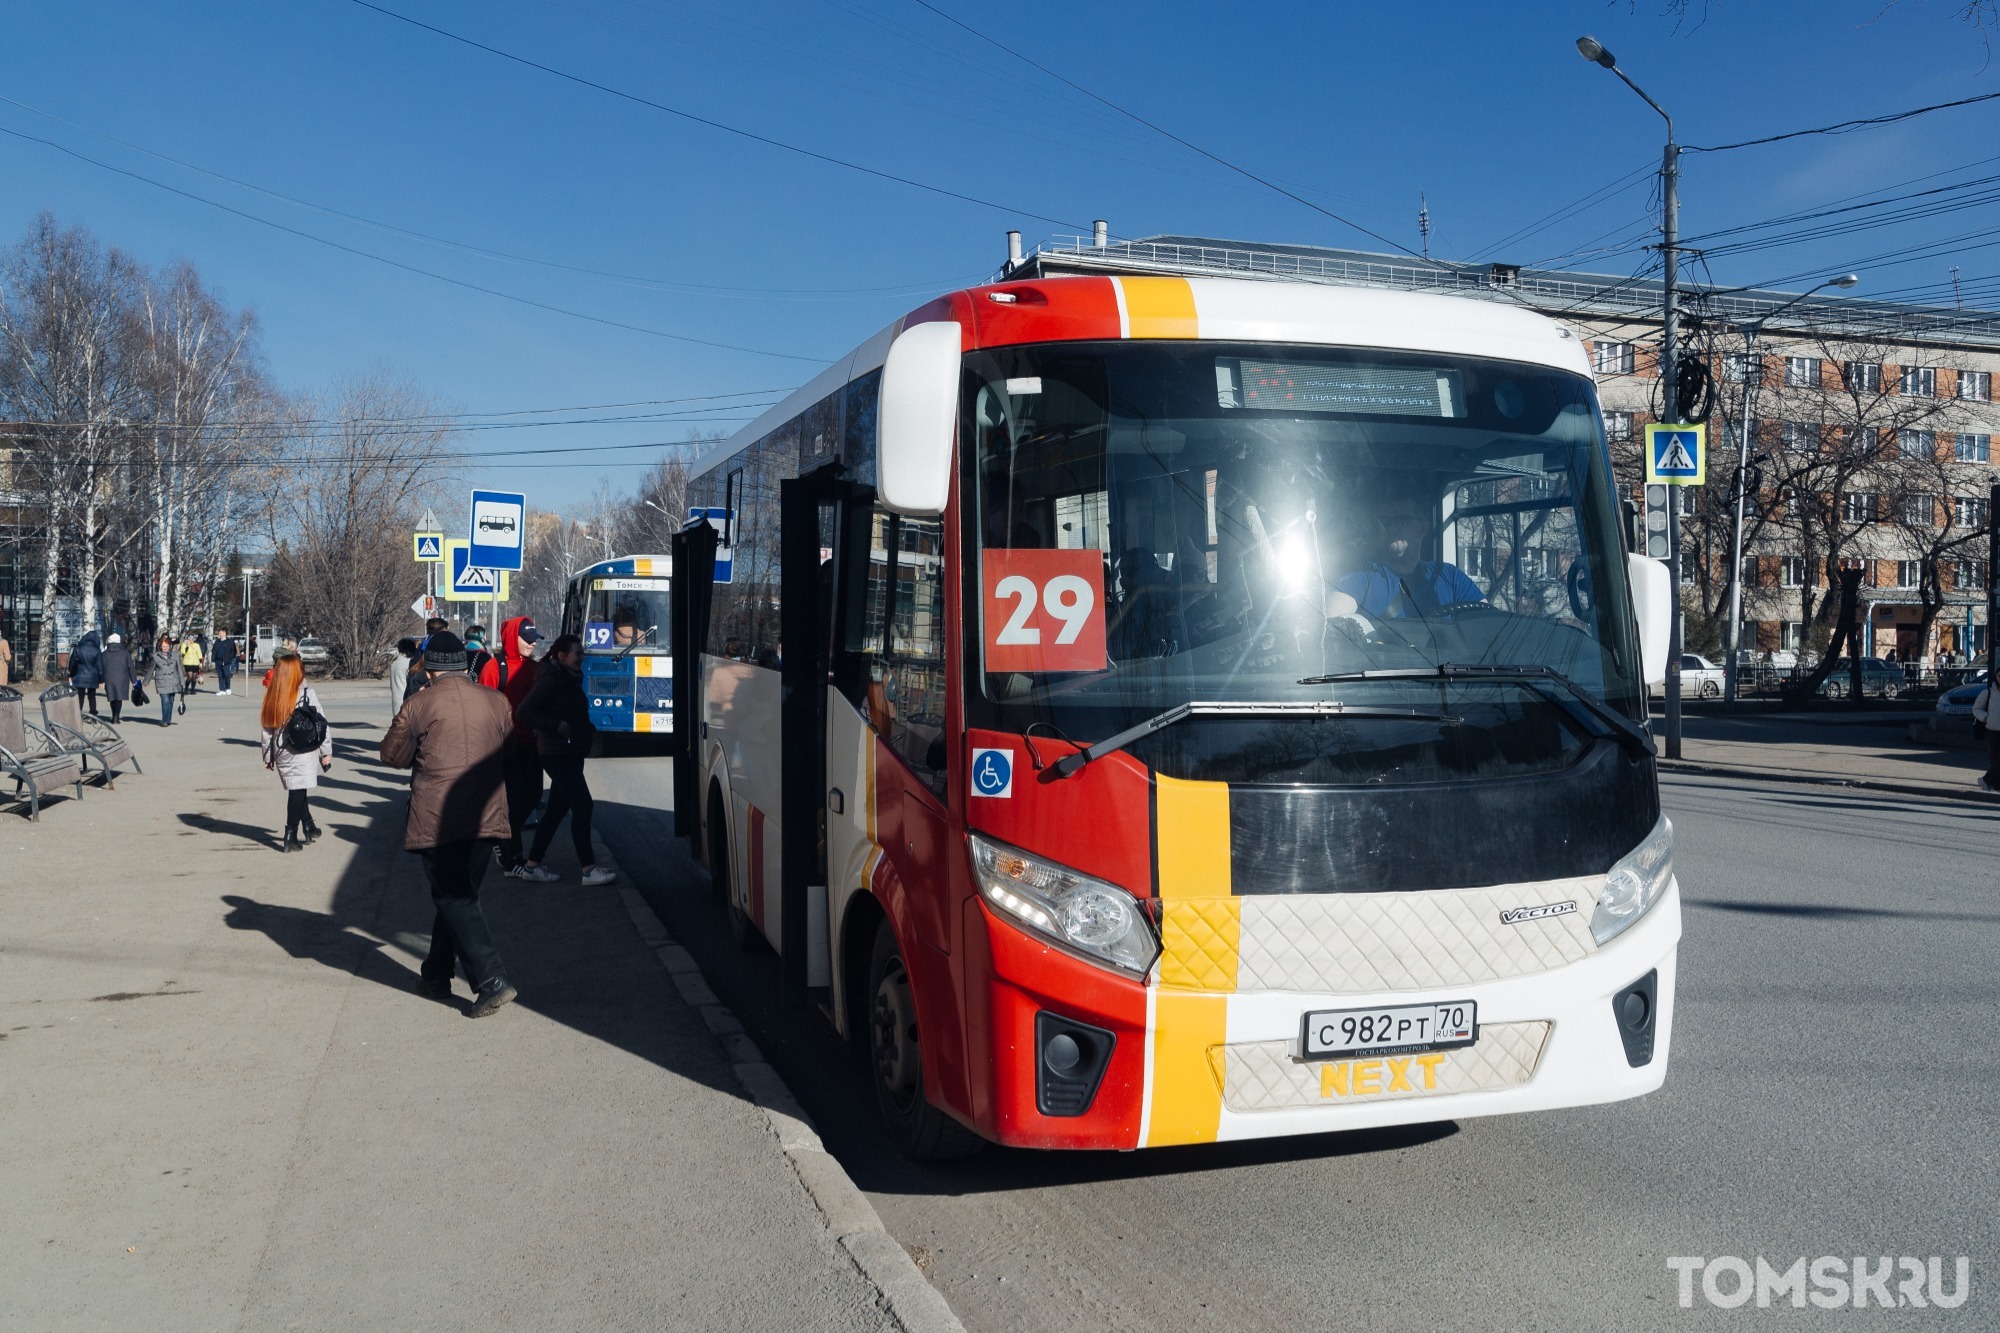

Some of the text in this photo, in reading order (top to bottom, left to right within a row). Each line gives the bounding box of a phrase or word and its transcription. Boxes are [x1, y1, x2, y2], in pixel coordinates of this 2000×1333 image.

[595, 581, 604, 589] 19
[617, 581, 643, 589] Томск
[995, 575, 1094, 645] 29
[589, 628, 610, 644] 19
[1439, 1007, 1464, 1029] 70
[1436, 1028, 1455, 1038] RUS
[1355, 1045, 1430, 1057] ГОСНАРКОКОНТРОЛЬ
[1321, 1053, 1445, 1098] NEXT
